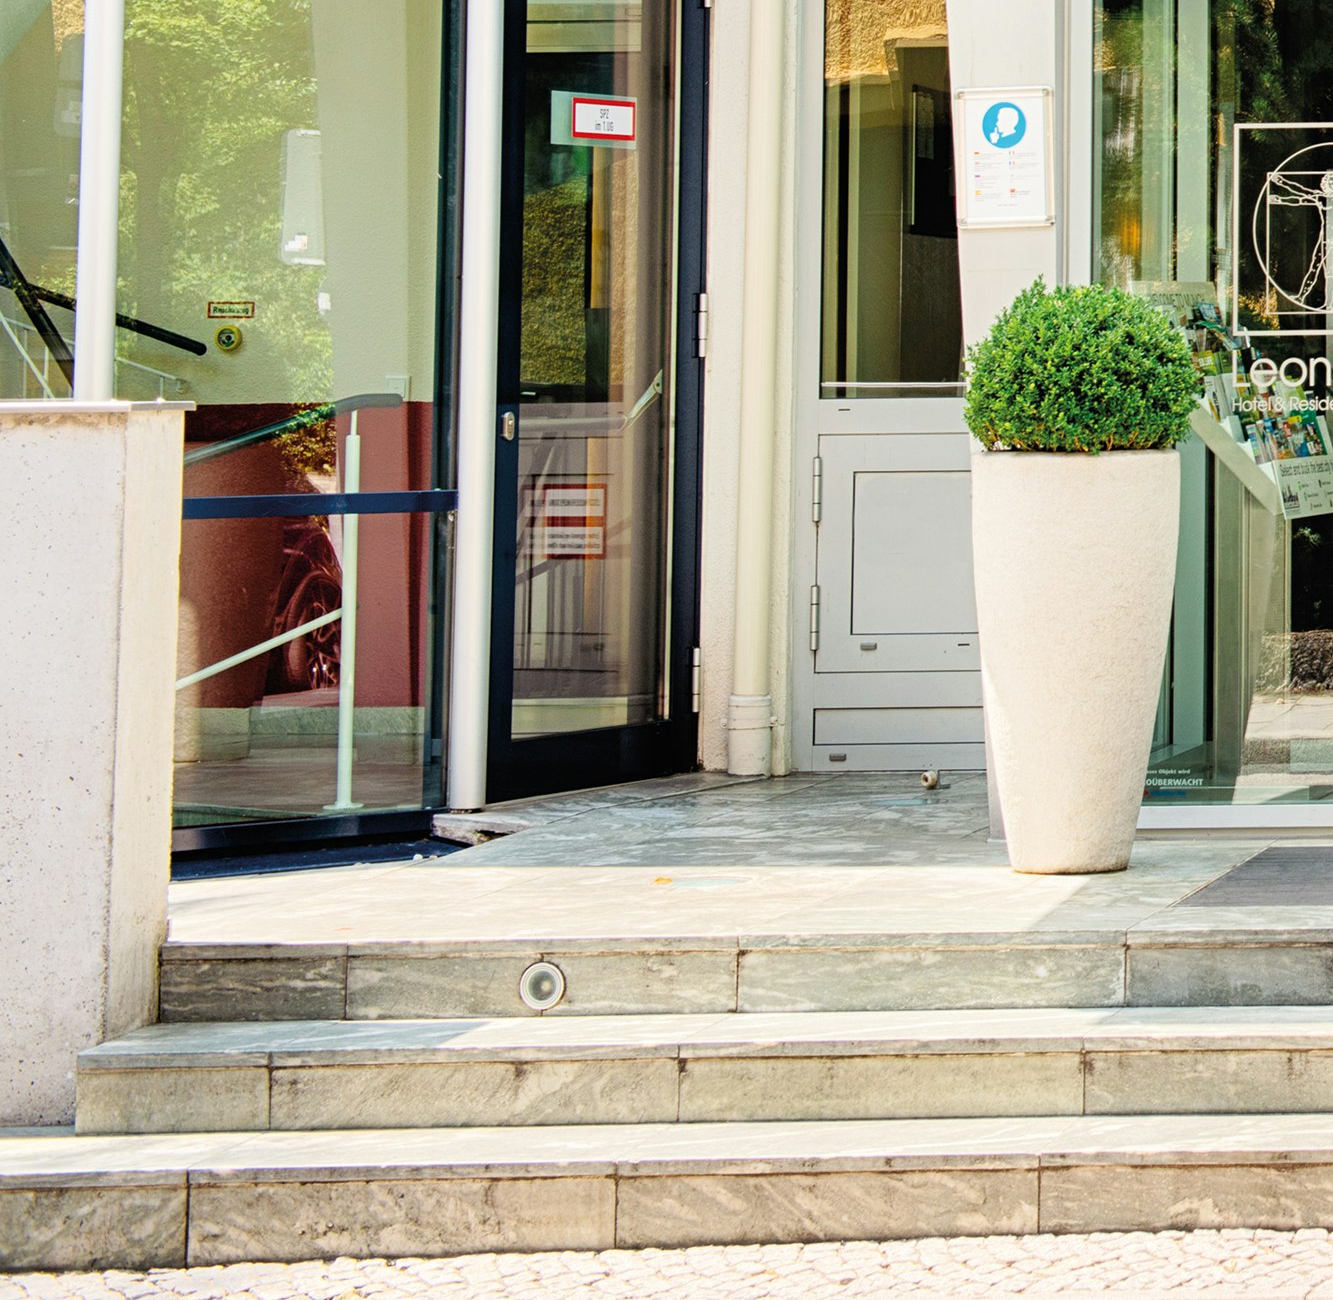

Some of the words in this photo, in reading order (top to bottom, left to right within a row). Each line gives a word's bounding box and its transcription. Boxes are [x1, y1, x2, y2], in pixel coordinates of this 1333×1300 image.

[1232, 395, 1272, 412] Hotel
[1274, 396, 1286, 411] &
[1145, 778, 1204, 786] OÜBERWACHT
